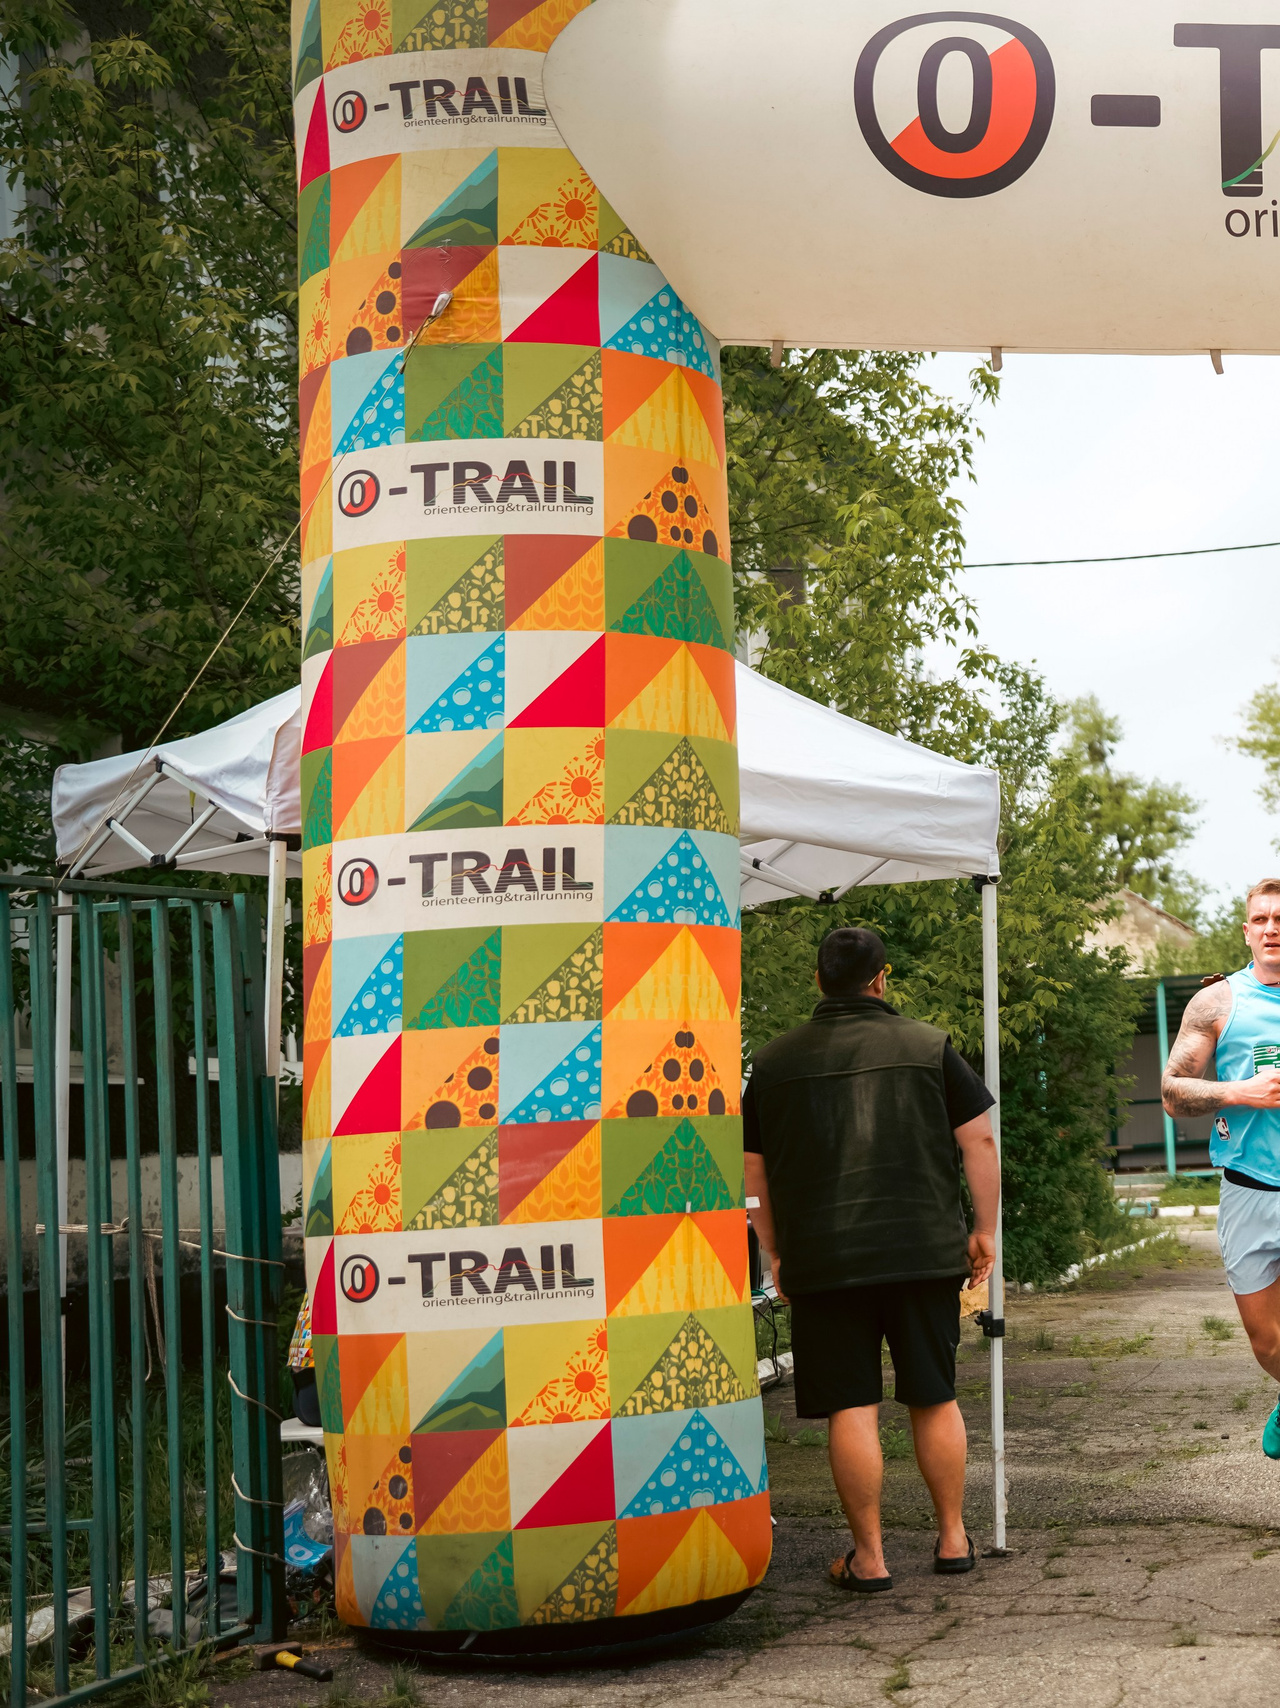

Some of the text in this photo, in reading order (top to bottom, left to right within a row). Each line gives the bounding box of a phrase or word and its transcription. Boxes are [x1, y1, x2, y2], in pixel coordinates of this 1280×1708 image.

[403, 114, 548, 128] orienteering&trailrunning
[423, 502, 594, 516] orienteering&trailrunning
[421, 890, 594, 908] orienteering&trailrunning
[422, 1287, 595, 1308] orienteering&trailrunning
